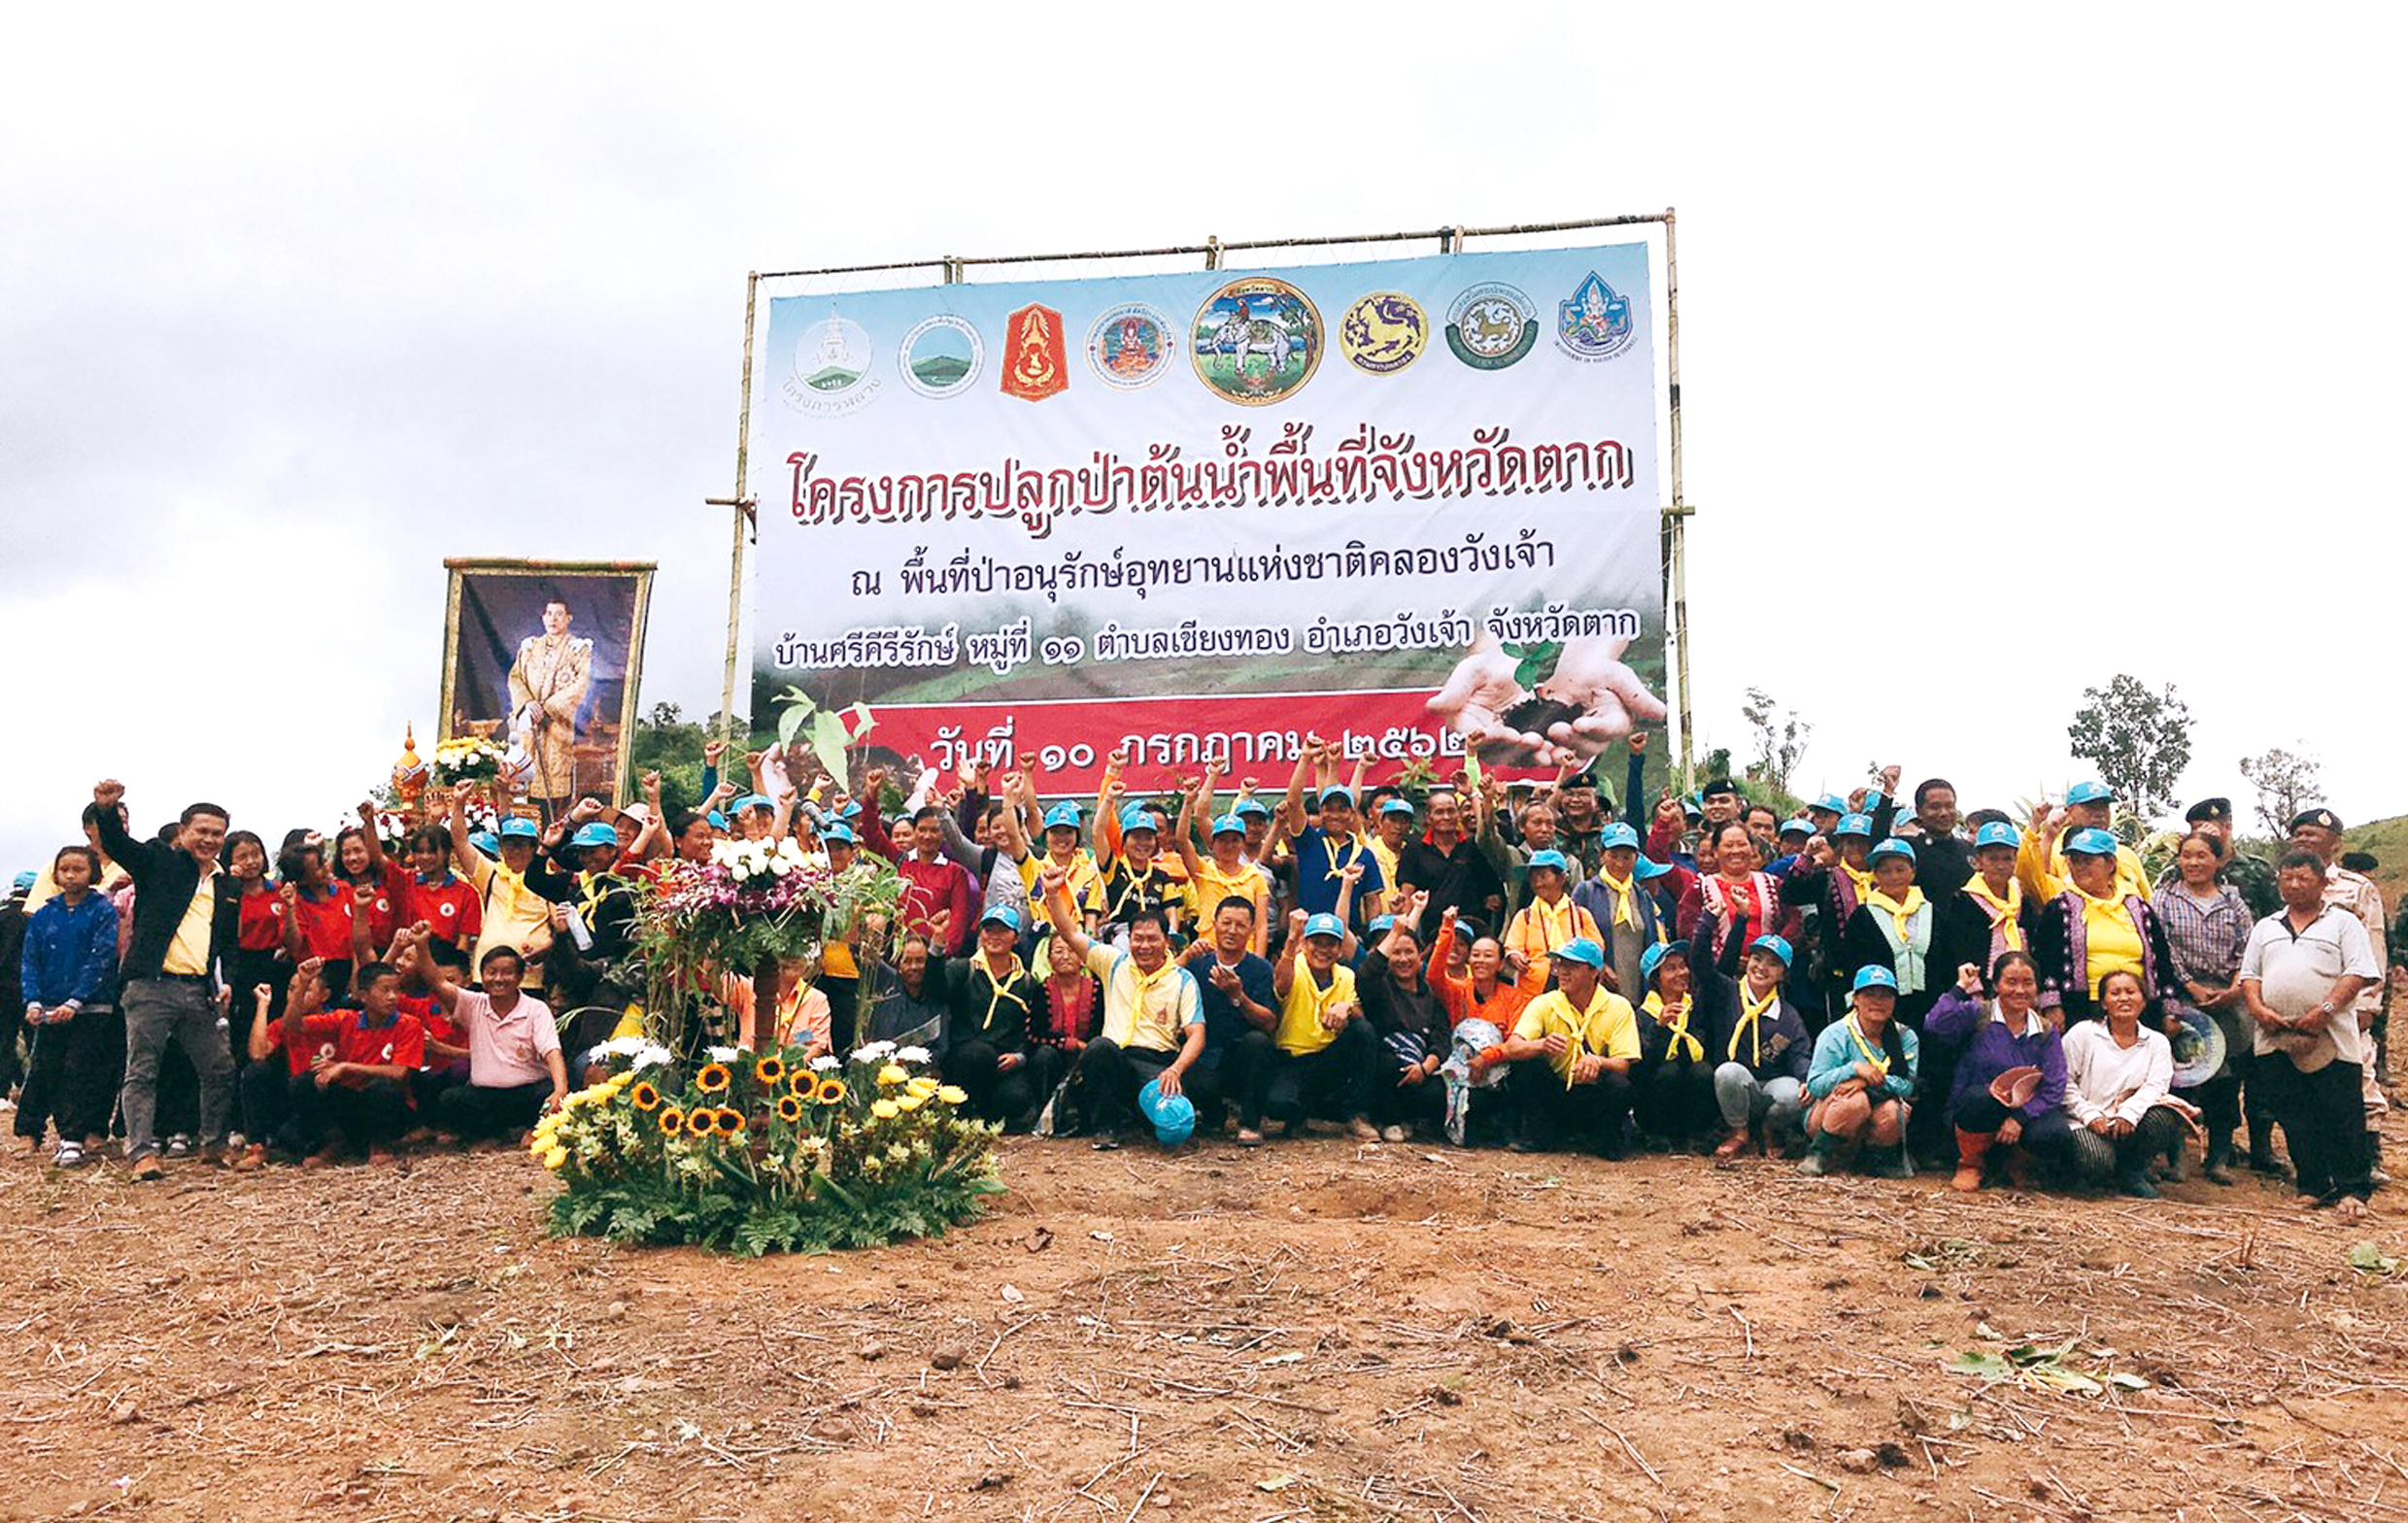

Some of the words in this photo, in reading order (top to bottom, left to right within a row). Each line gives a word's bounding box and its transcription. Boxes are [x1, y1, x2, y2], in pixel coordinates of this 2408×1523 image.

[787, 421, 1633, 539] โครงการปลูกป่าต้นน้ำพื้นที่จังหวัดตาก
[852, 568, 881, 595] ณ
[900, 528, 1554, 602] พื้นที่ป่าอนุรักษ์อุทยานแห่งชาติคลองวังเจ้า
[776, 626, 956, 665] บ้านศรีคีรีรักษ์
[969, 621, 1030, 670] หมู่ที่
[1044, 640, 1081, 660] ๑๑
[1099, 619, 1289, 656] ตำบลเชียงทอง
[1308, 610, 1471, 649] อำเภอวังเจ้า
[1488, 604, 1637, 640] จังหวัดตาก
[930, 716, 1014, 771] วันที่
[1040, 744, 1095, 772] ๑๐
[1342, 726, 1468, 760] ๒๕๖๒
